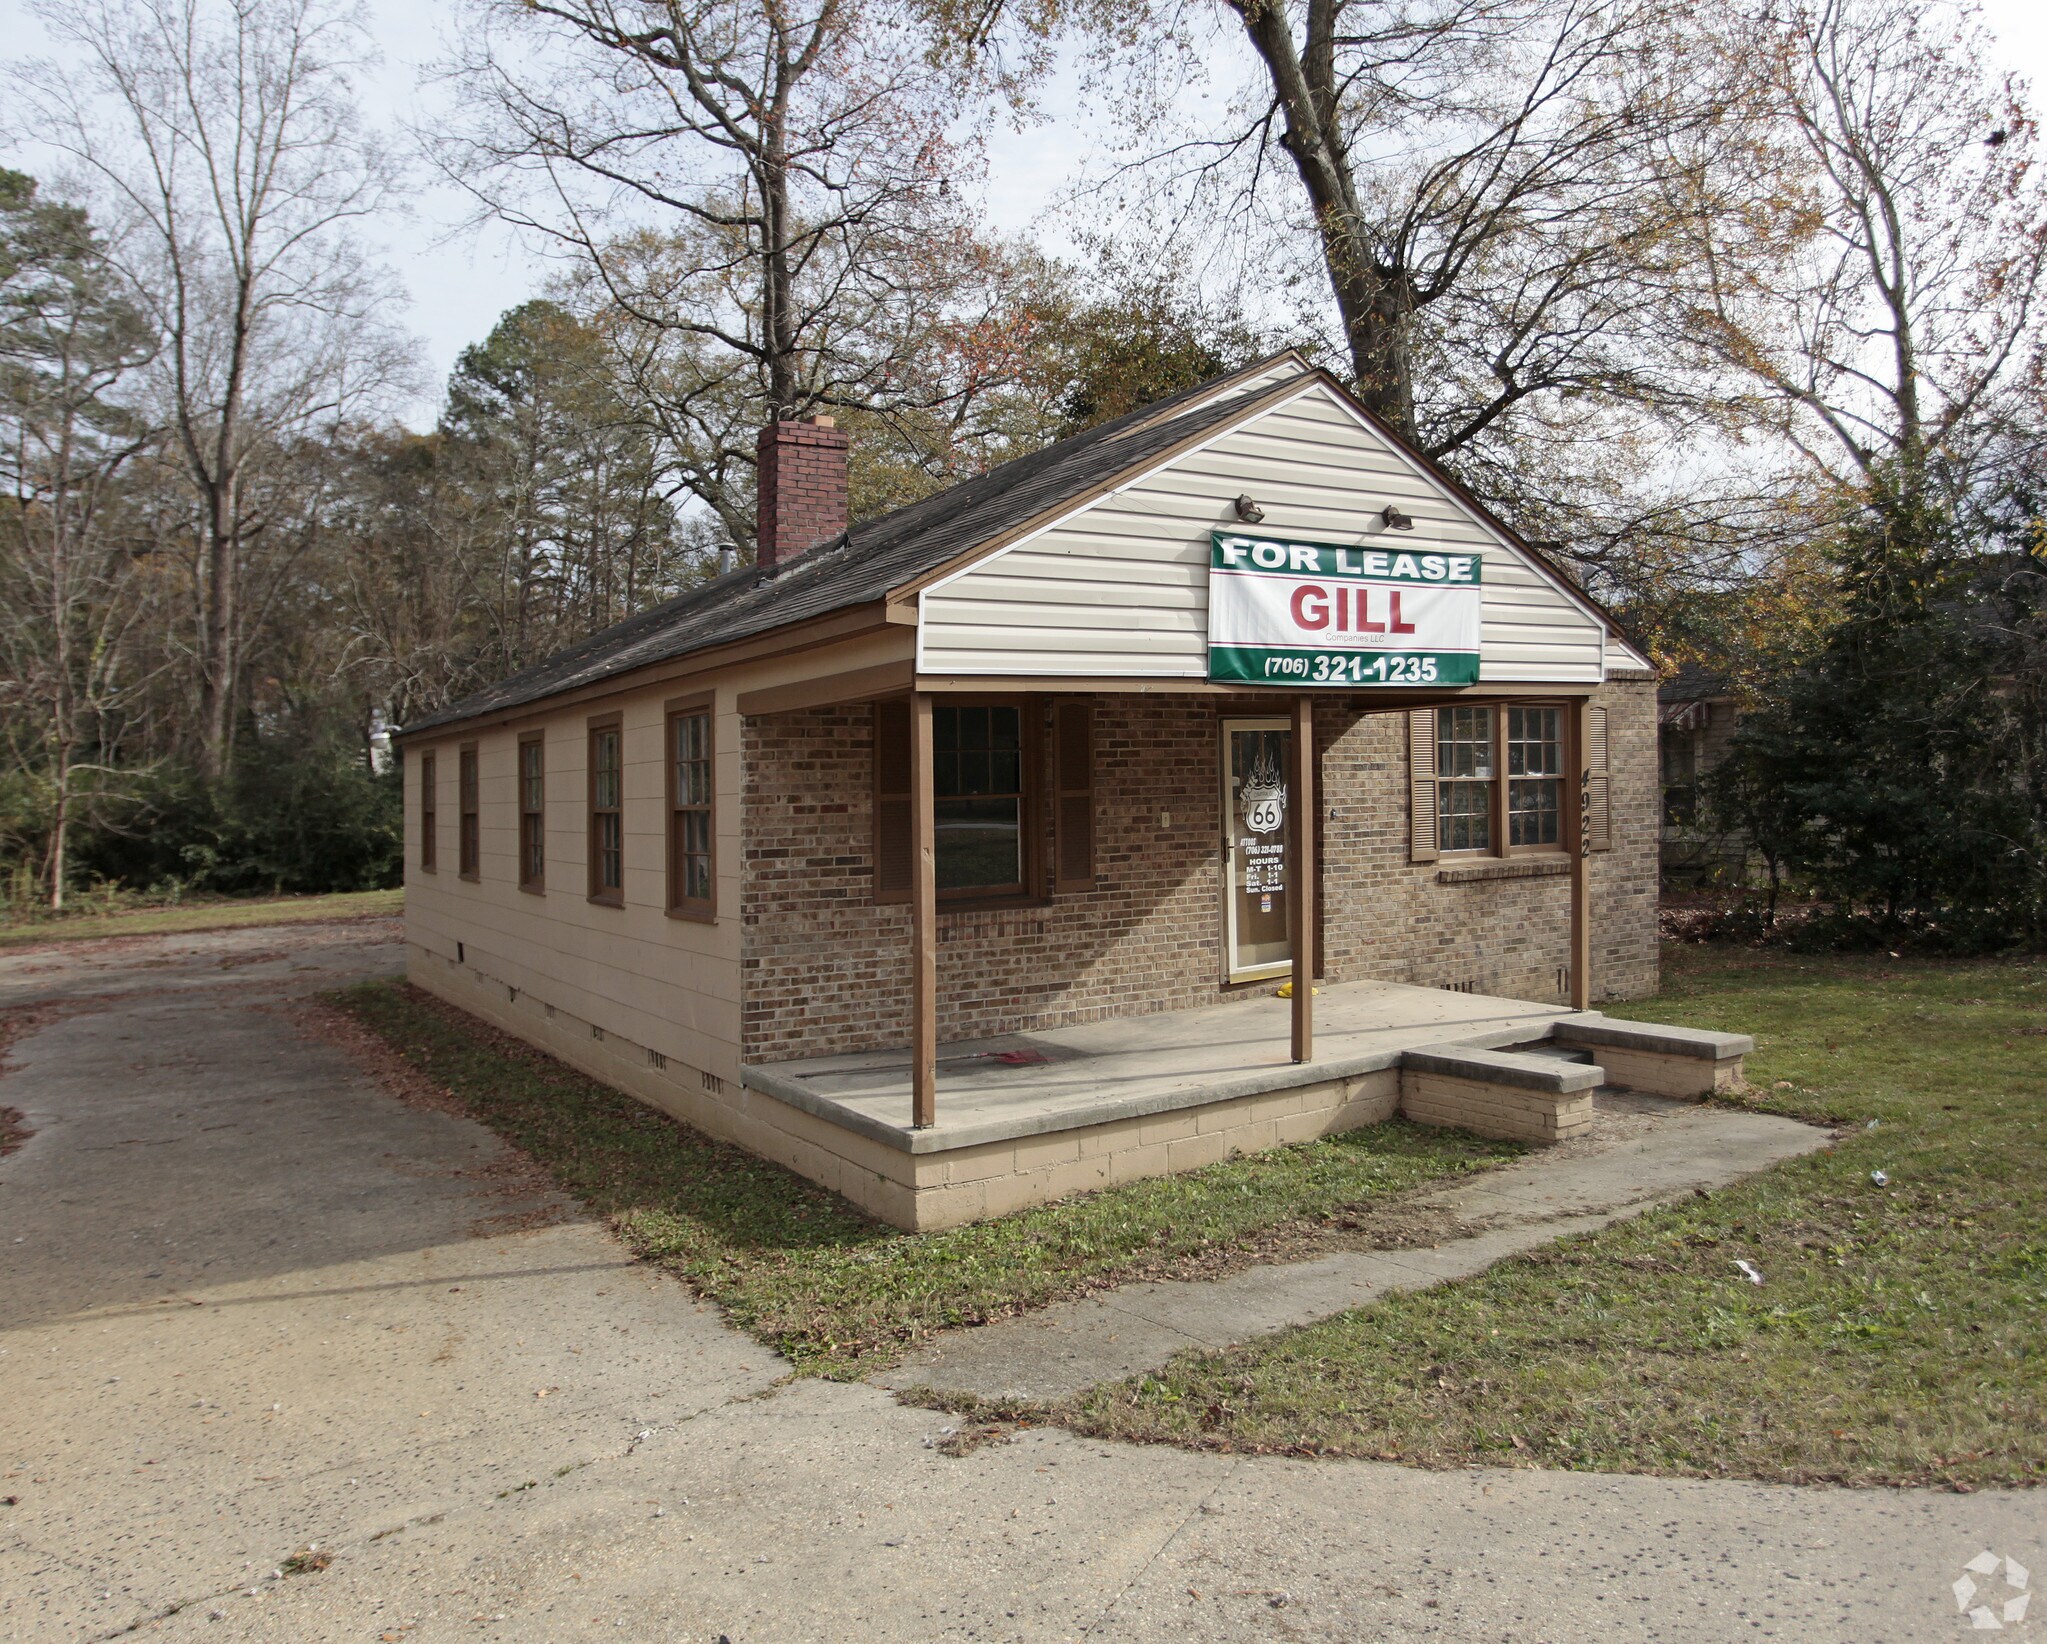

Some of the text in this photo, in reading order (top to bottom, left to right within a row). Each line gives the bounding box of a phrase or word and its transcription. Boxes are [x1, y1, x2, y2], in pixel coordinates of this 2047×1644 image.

[1221, 538, 1473, 581] FOR LEASE
[1290, 584, 1415, 634] GILL
[1325, 632, 1385, 643] Companies LLC
[1264, 656, 1437, 682] (706) 321-1235
[1253, 803, 1275, 825] 66
[1581, 768, 1590, 858] 4922
[1245, 846, 1260, 855] (706)
[1249, 857, 1279, 865] HOURS
[1261, 884, 1283, 892] Closed
